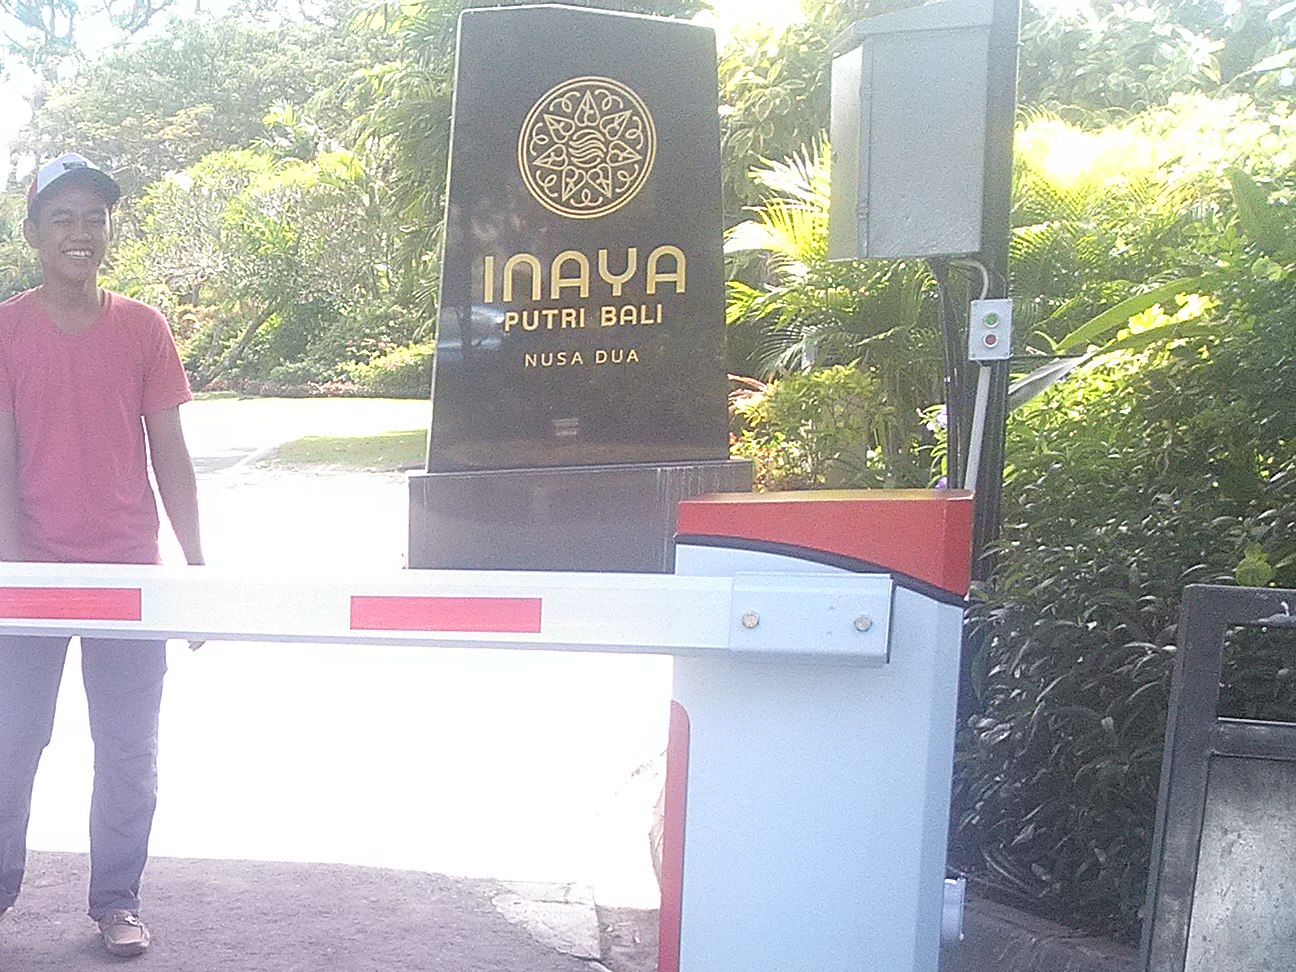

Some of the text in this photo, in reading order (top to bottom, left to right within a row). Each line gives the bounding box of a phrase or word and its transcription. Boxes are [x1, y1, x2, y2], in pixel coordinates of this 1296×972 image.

[483, 245, 686, 303] INAYA
[504, 304, 663, 332] PUTRI BALI
[524, 350, 640, 368] NUSA DUA
